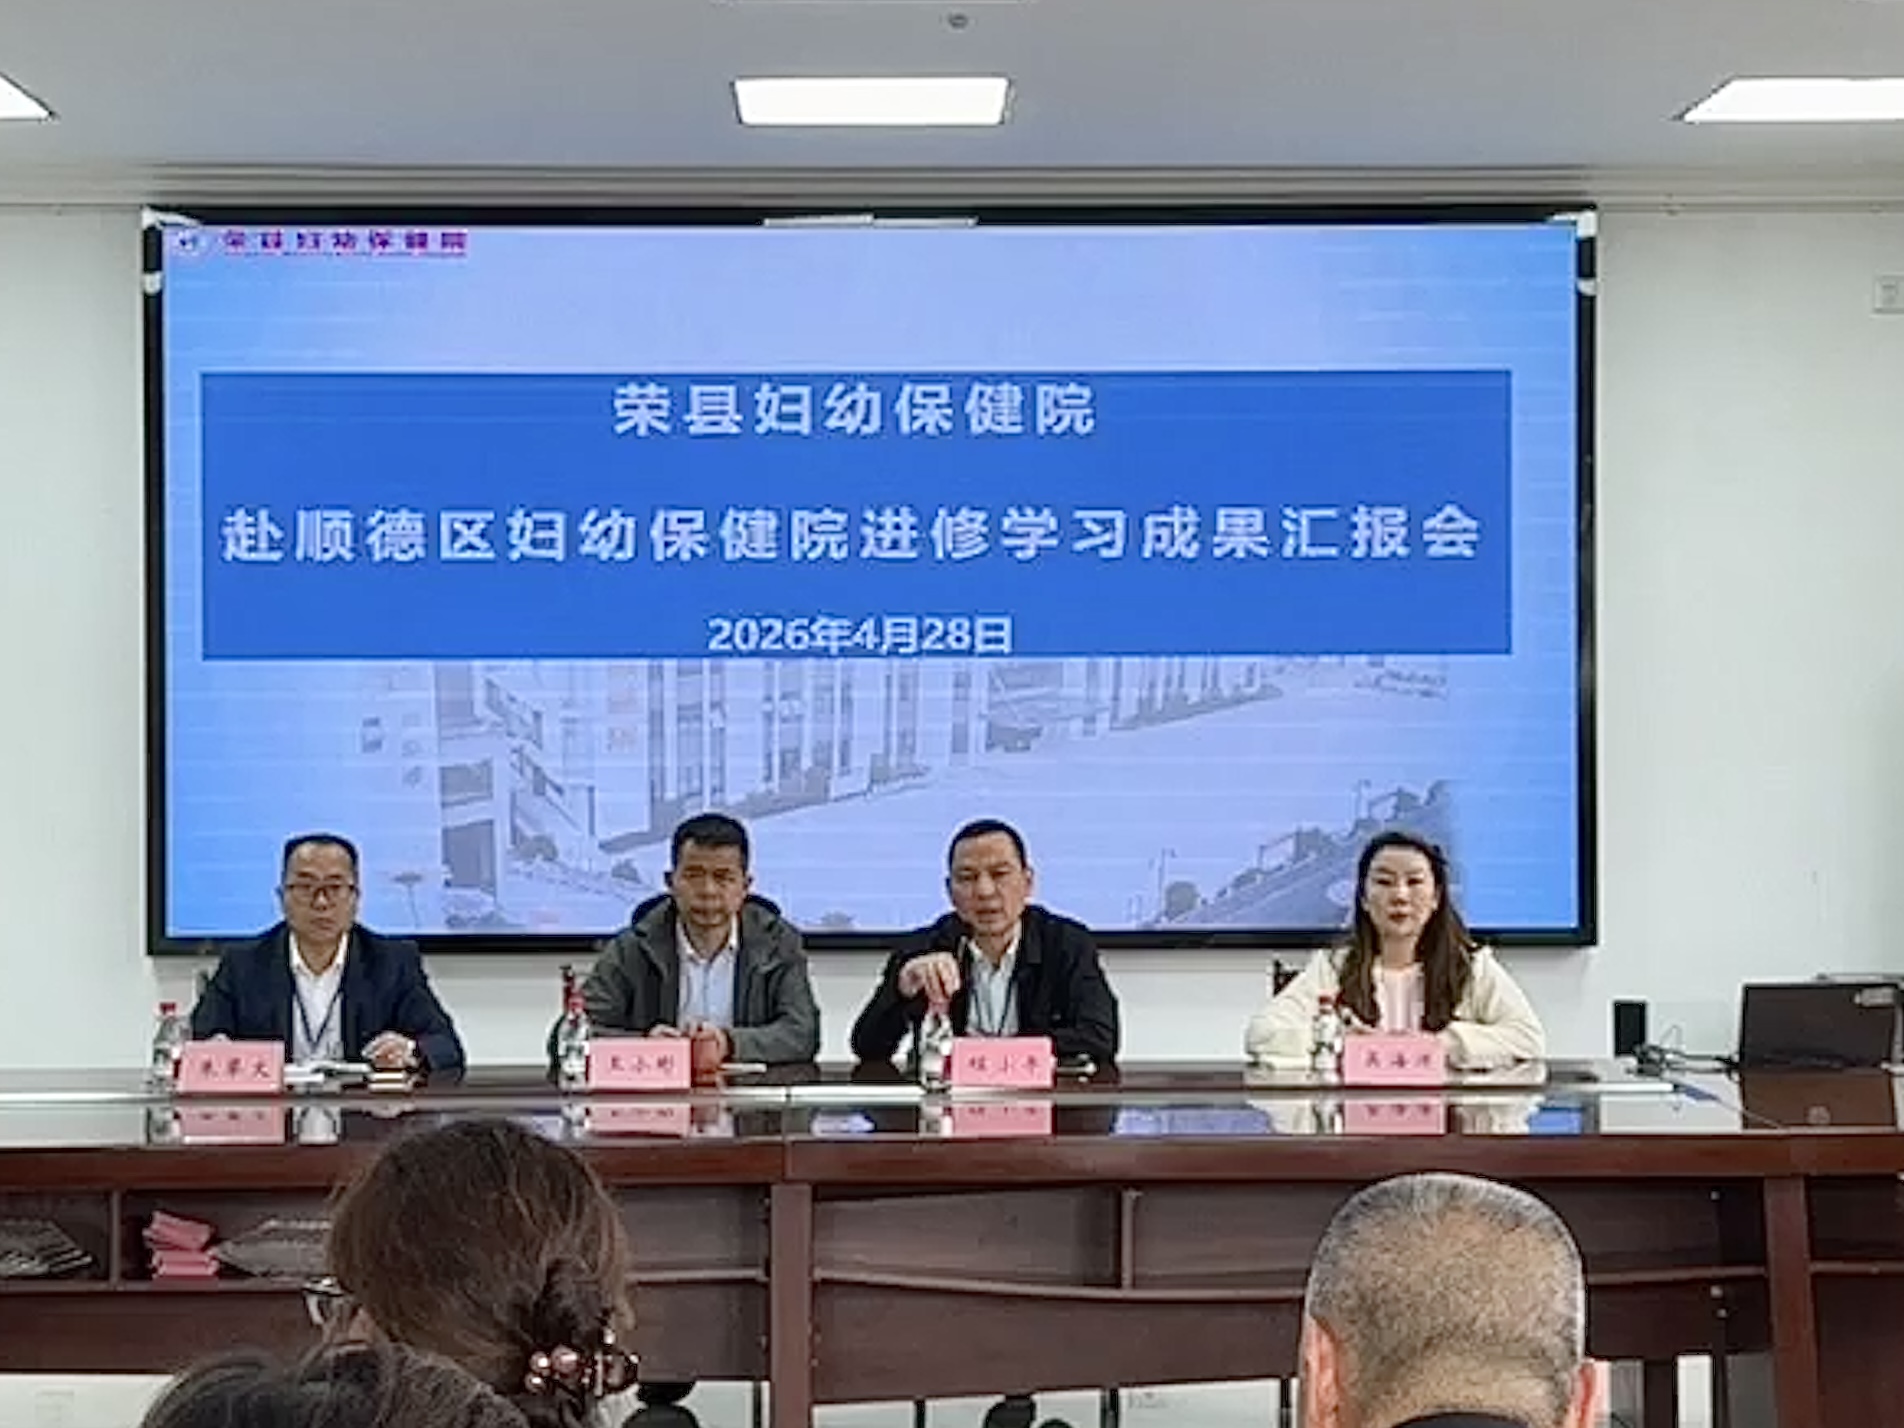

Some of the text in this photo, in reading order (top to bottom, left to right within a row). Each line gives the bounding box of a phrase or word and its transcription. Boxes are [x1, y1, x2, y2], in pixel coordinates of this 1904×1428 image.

[613, 381, 1098, 438] 荣县妇幼保健院
[220, 504, 1481, 563] 赴顺德区妇幼保健院进修学习成果汇报会
[706, 613, 1014, 655] 2026年4月28日
